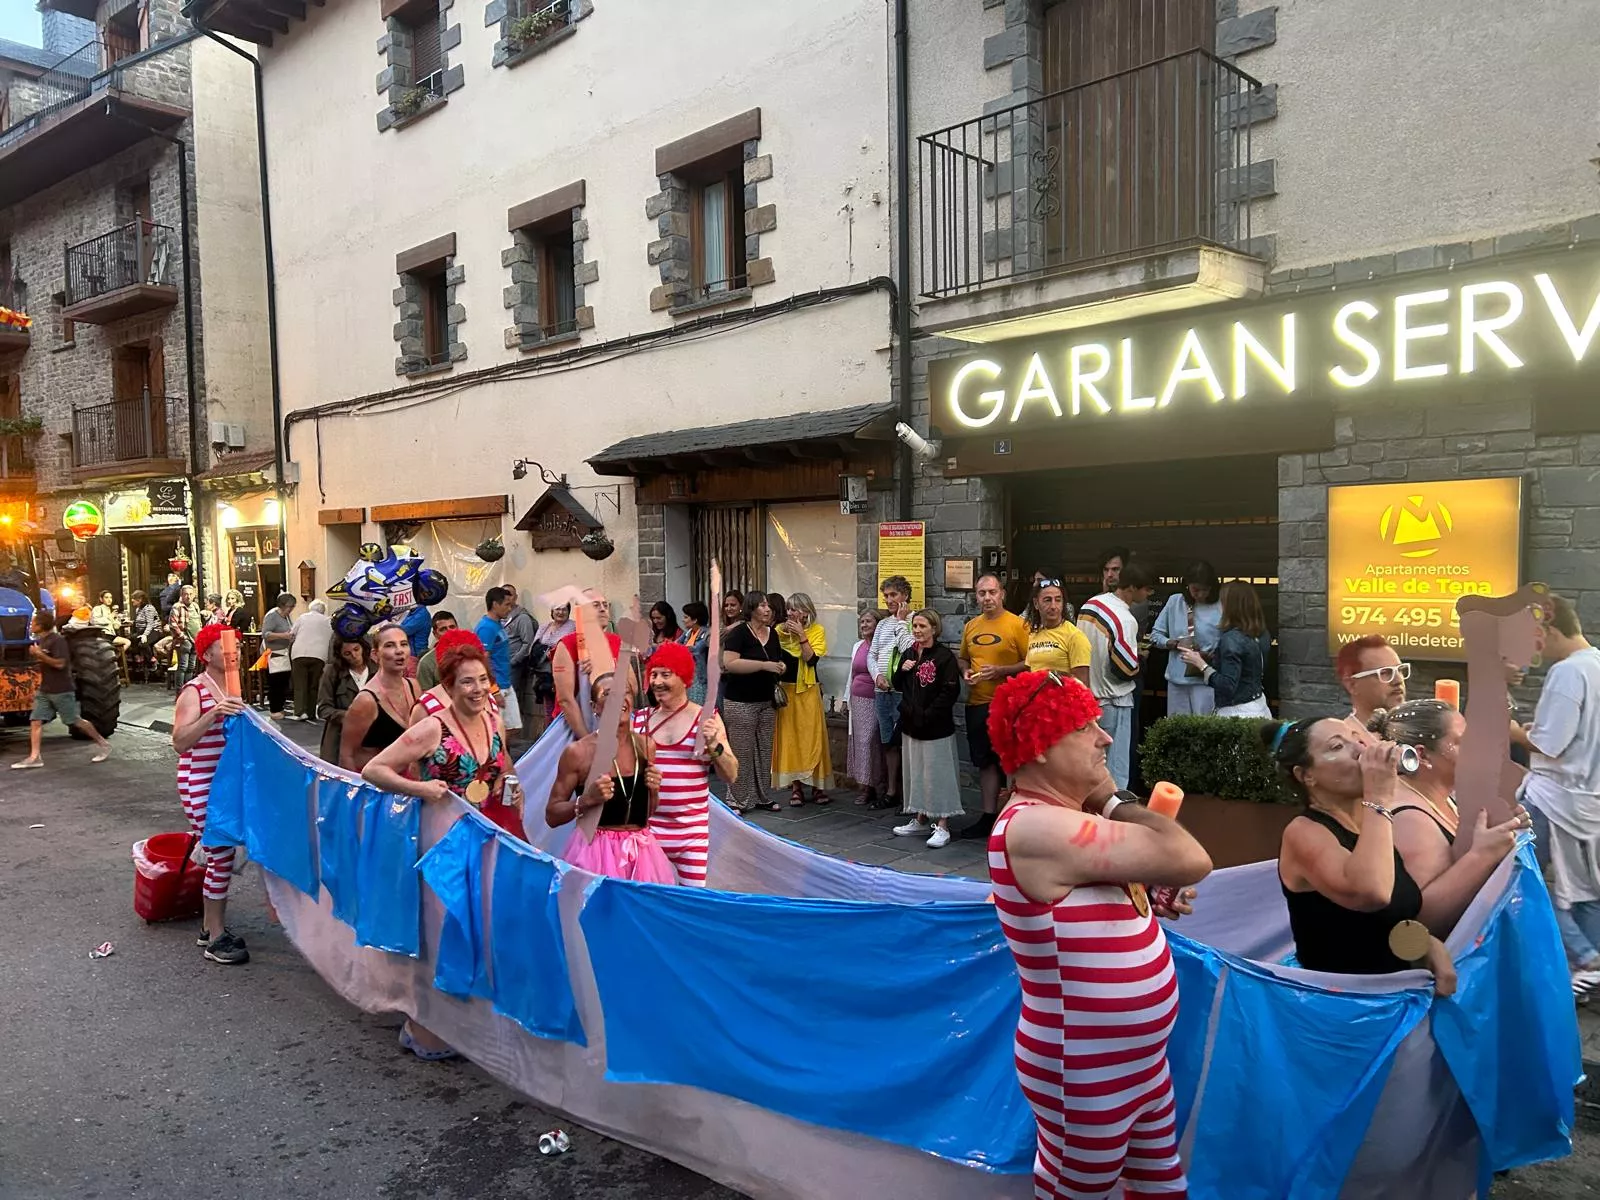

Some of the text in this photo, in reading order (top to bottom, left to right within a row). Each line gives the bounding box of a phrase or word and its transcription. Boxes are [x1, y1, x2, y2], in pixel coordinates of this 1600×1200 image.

[949, 272, 1600, 428] GARLAN SERV
[999, 440, 1005, 453] 2
[1365, 563, 1470, 577] Apartamentos
[1345, 578, 1493, 594] Valle de Tena
[1340, 606, 1387, 626] 974
[1393, 608, 1442, 627] 495
